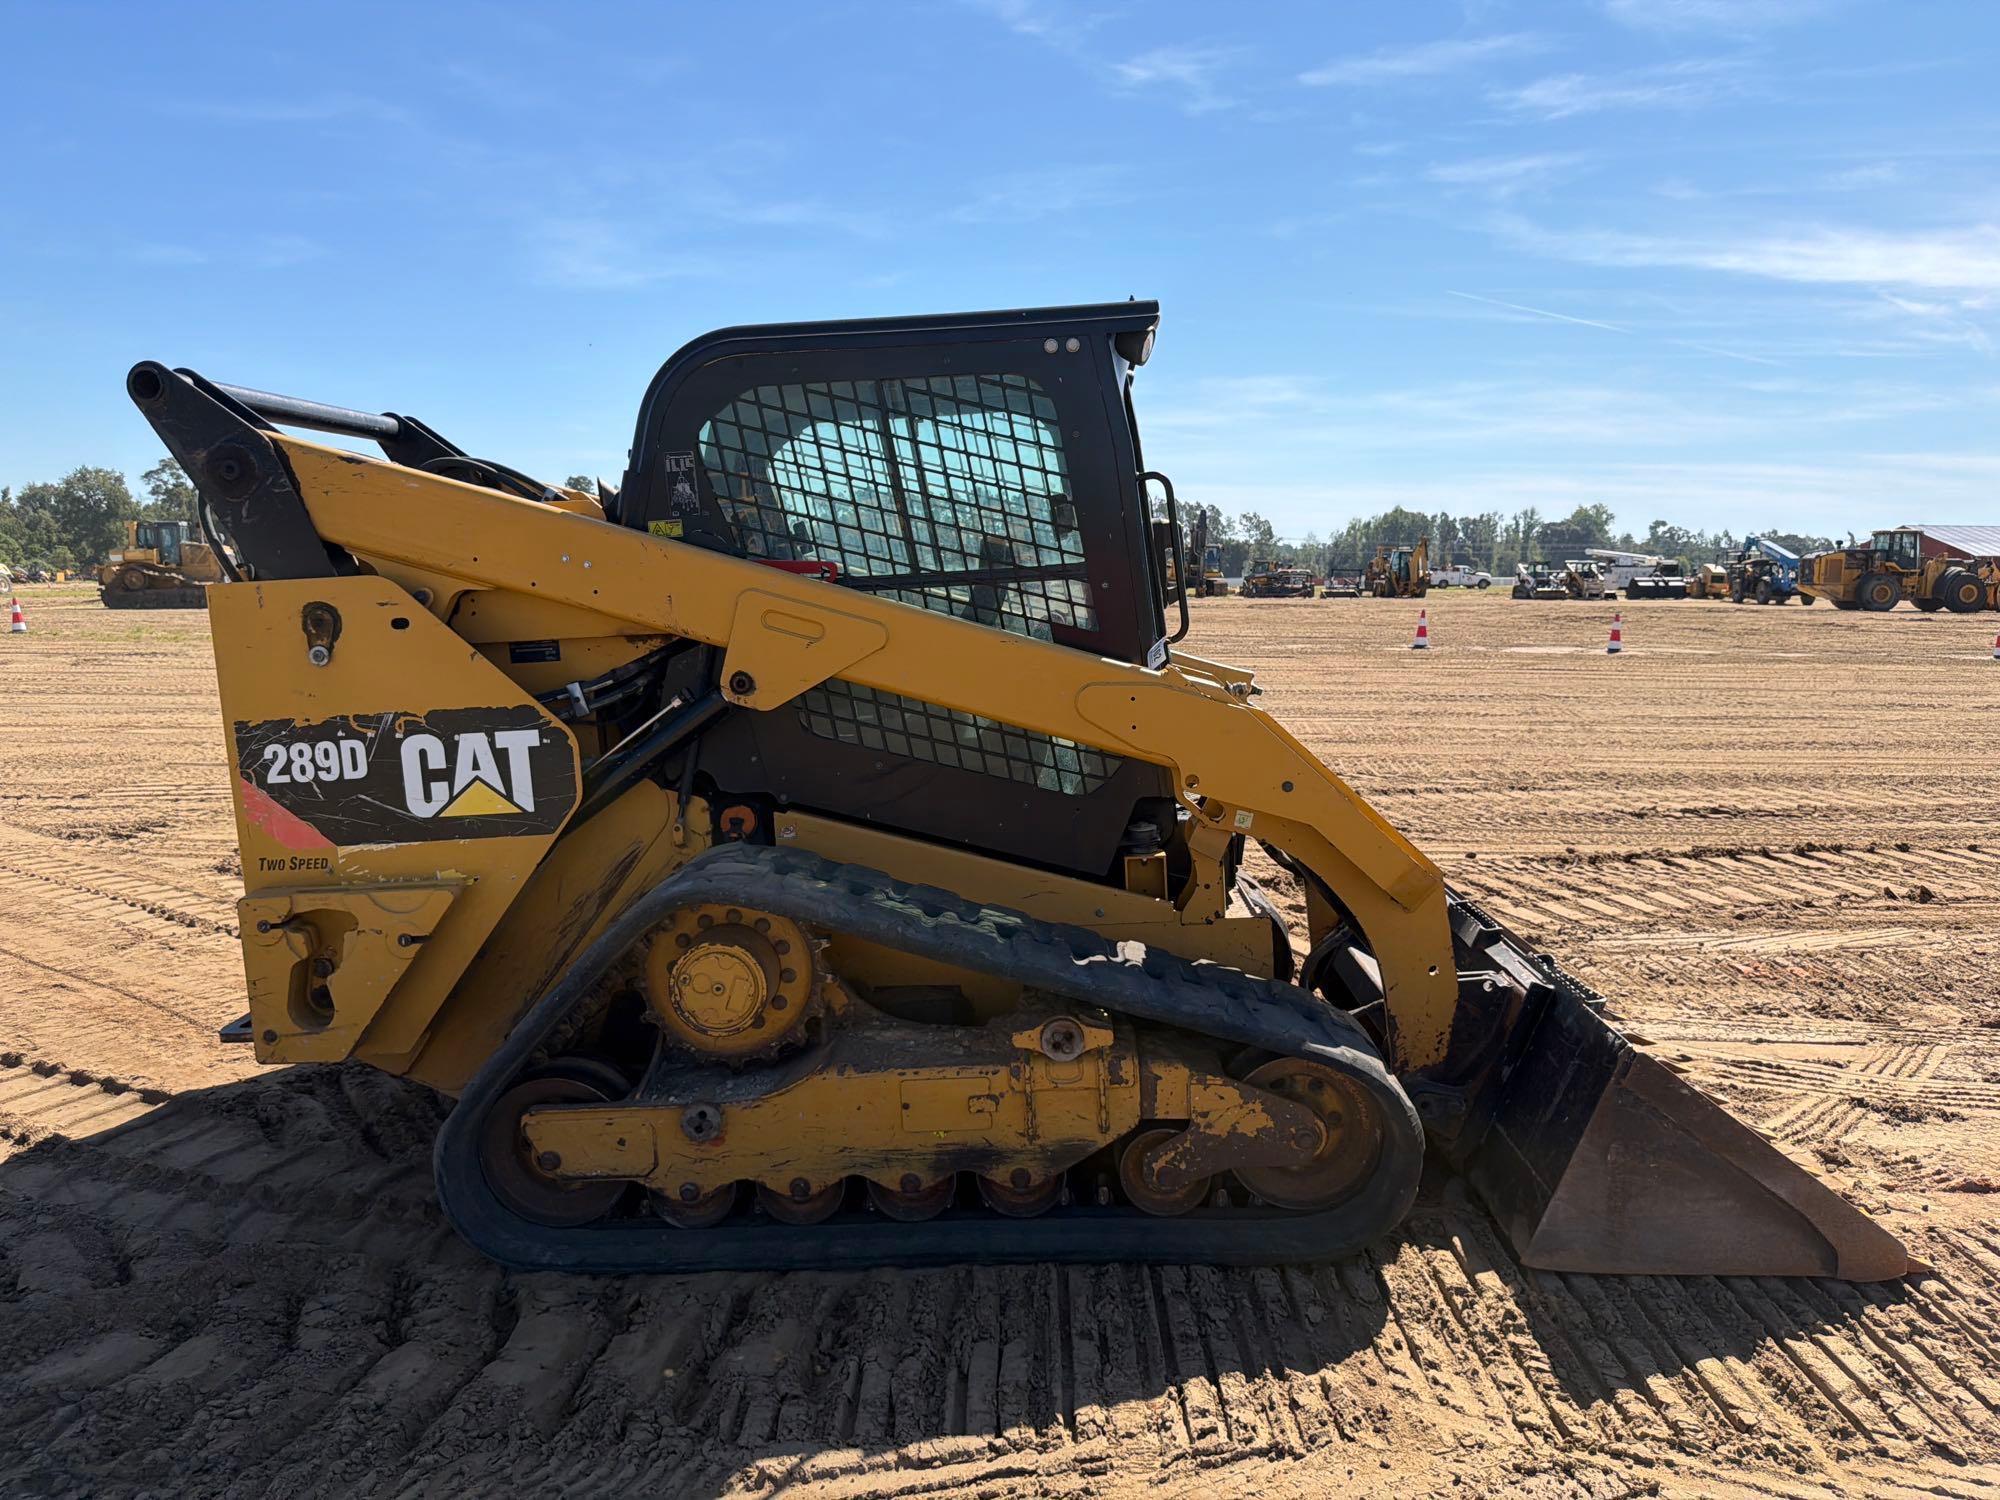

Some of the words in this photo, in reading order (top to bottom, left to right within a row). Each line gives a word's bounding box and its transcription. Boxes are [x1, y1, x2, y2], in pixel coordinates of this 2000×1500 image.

[263, 739, 368, 784] 289D
[400, 730, 541, 818] CAT
[258, 857, 286, 871] TWO
[289, 856, 329, 870] SPEED
